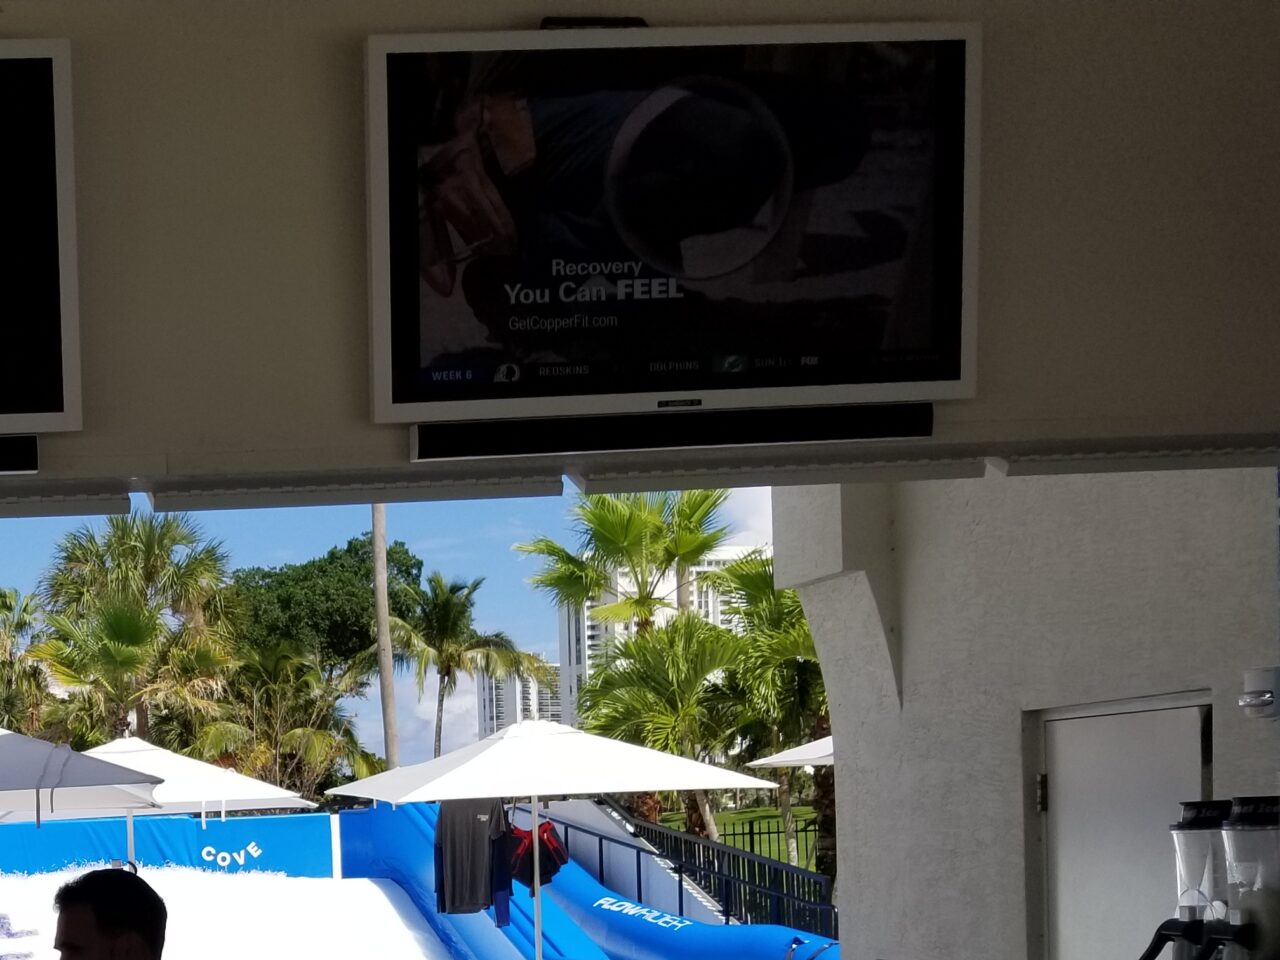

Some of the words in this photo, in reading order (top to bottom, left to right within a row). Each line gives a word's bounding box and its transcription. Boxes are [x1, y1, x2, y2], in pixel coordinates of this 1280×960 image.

[551, 258, 642, 277] Recovery
[504, 283, 550, 304] You
[558, 281, 606, 302] Can
[616, 278, 684, 300] FEEL
[508, 314, 618, 332] GetCopperFit.com
[539, 364, 590, 376] REDSKINS
[649, 360, 700, 372] DOLPHINS
[431, 370, 462, 381] WEEK
[201, 841, 263, 867] COVE
